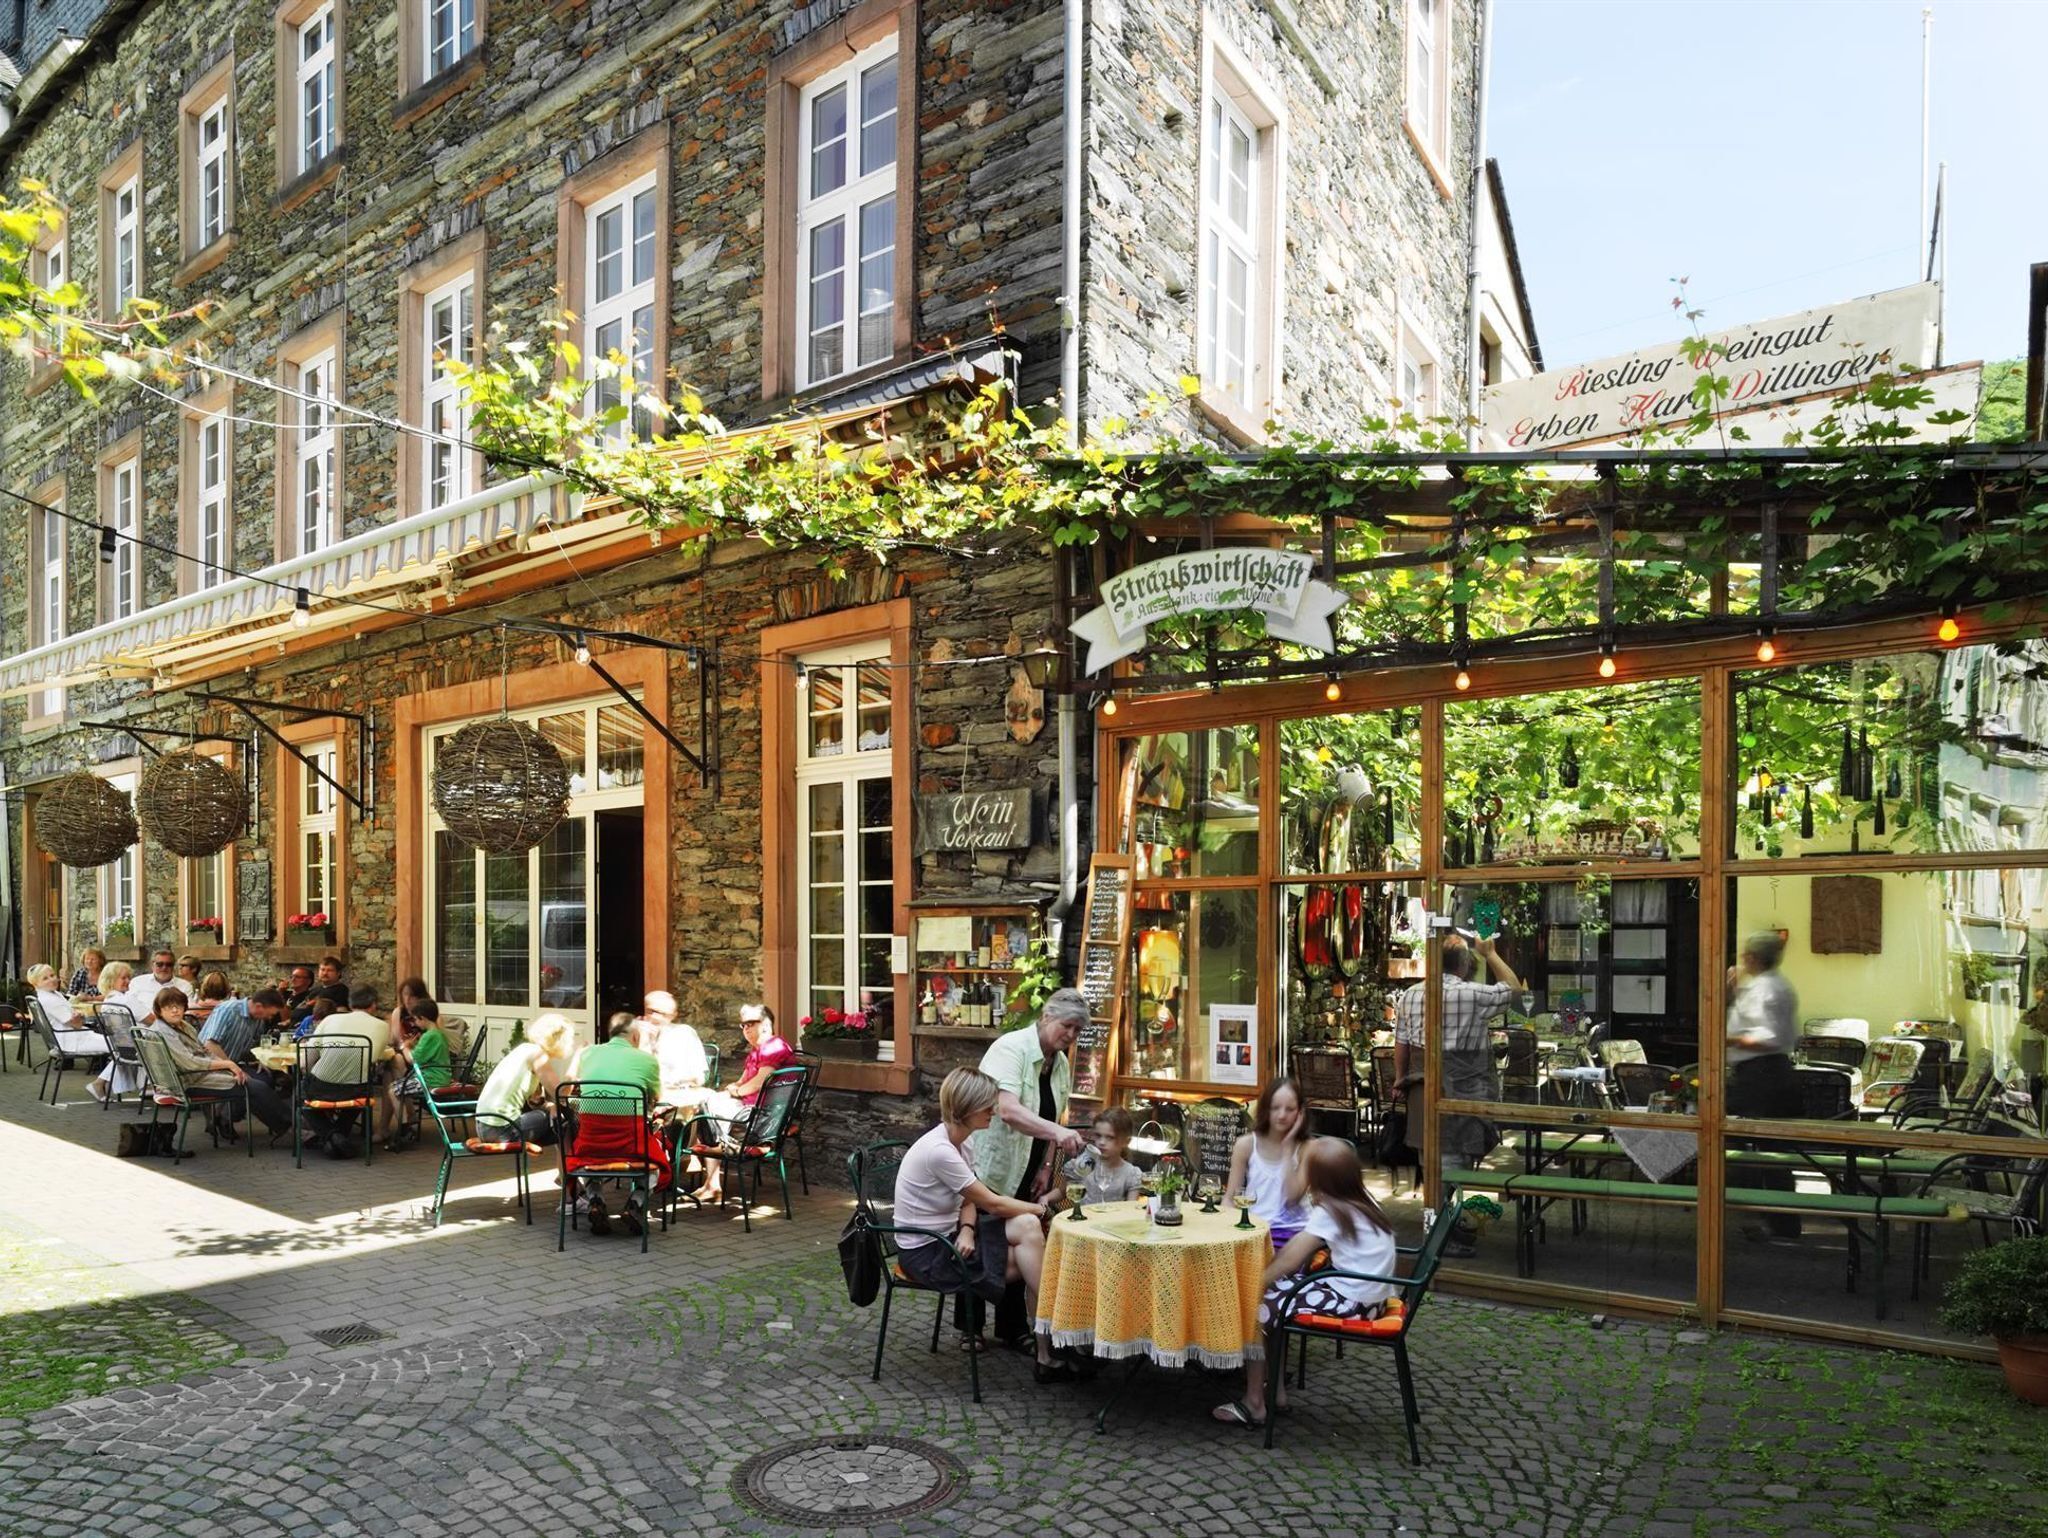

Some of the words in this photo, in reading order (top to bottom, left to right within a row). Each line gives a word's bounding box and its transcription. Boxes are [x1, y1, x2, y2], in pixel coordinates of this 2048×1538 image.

[1506, 413, 1599, 447] Erben
[1621, 388, 1706, 424] Kar
[1729, 347, 1895, 401] Dillinger
[951, 794, 1013, 825] Wein
[942, 823, 1016, 848] Verkauf
